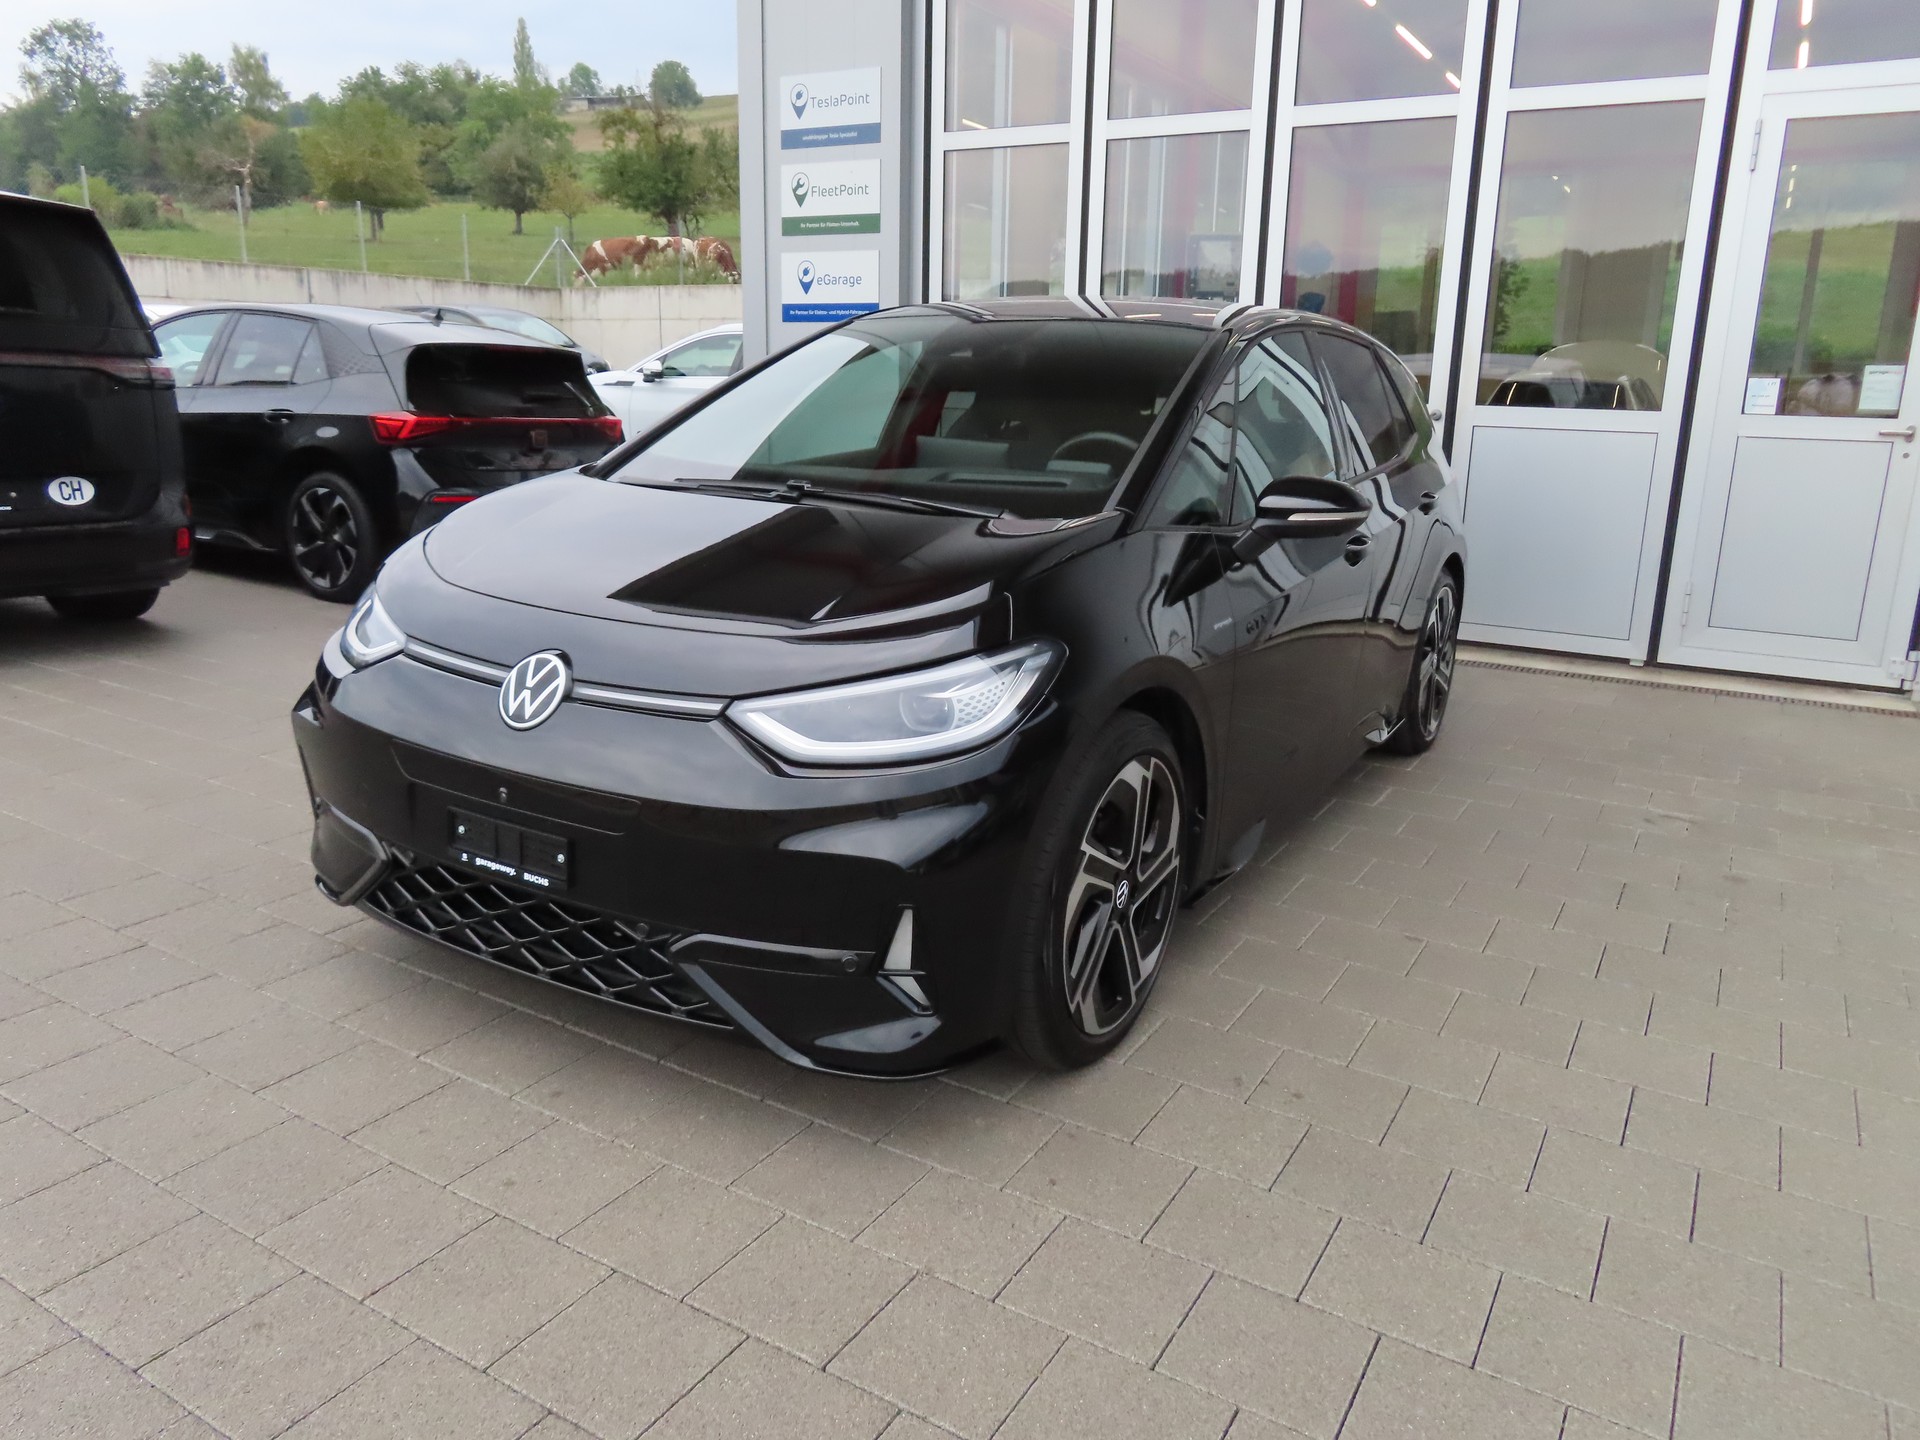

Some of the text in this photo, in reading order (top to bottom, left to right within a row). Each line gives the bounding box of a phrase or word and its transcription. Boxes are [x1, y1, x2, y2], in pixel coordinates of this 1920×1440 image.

[810, 92, 870, 109] TeslaPoint
[811, 183, 869, 198] FleetPoint
[816, 274, 862, 288] eGarage
[58, 480, 84, 501] CH
[523, 872, 549, 887] BUCHS
